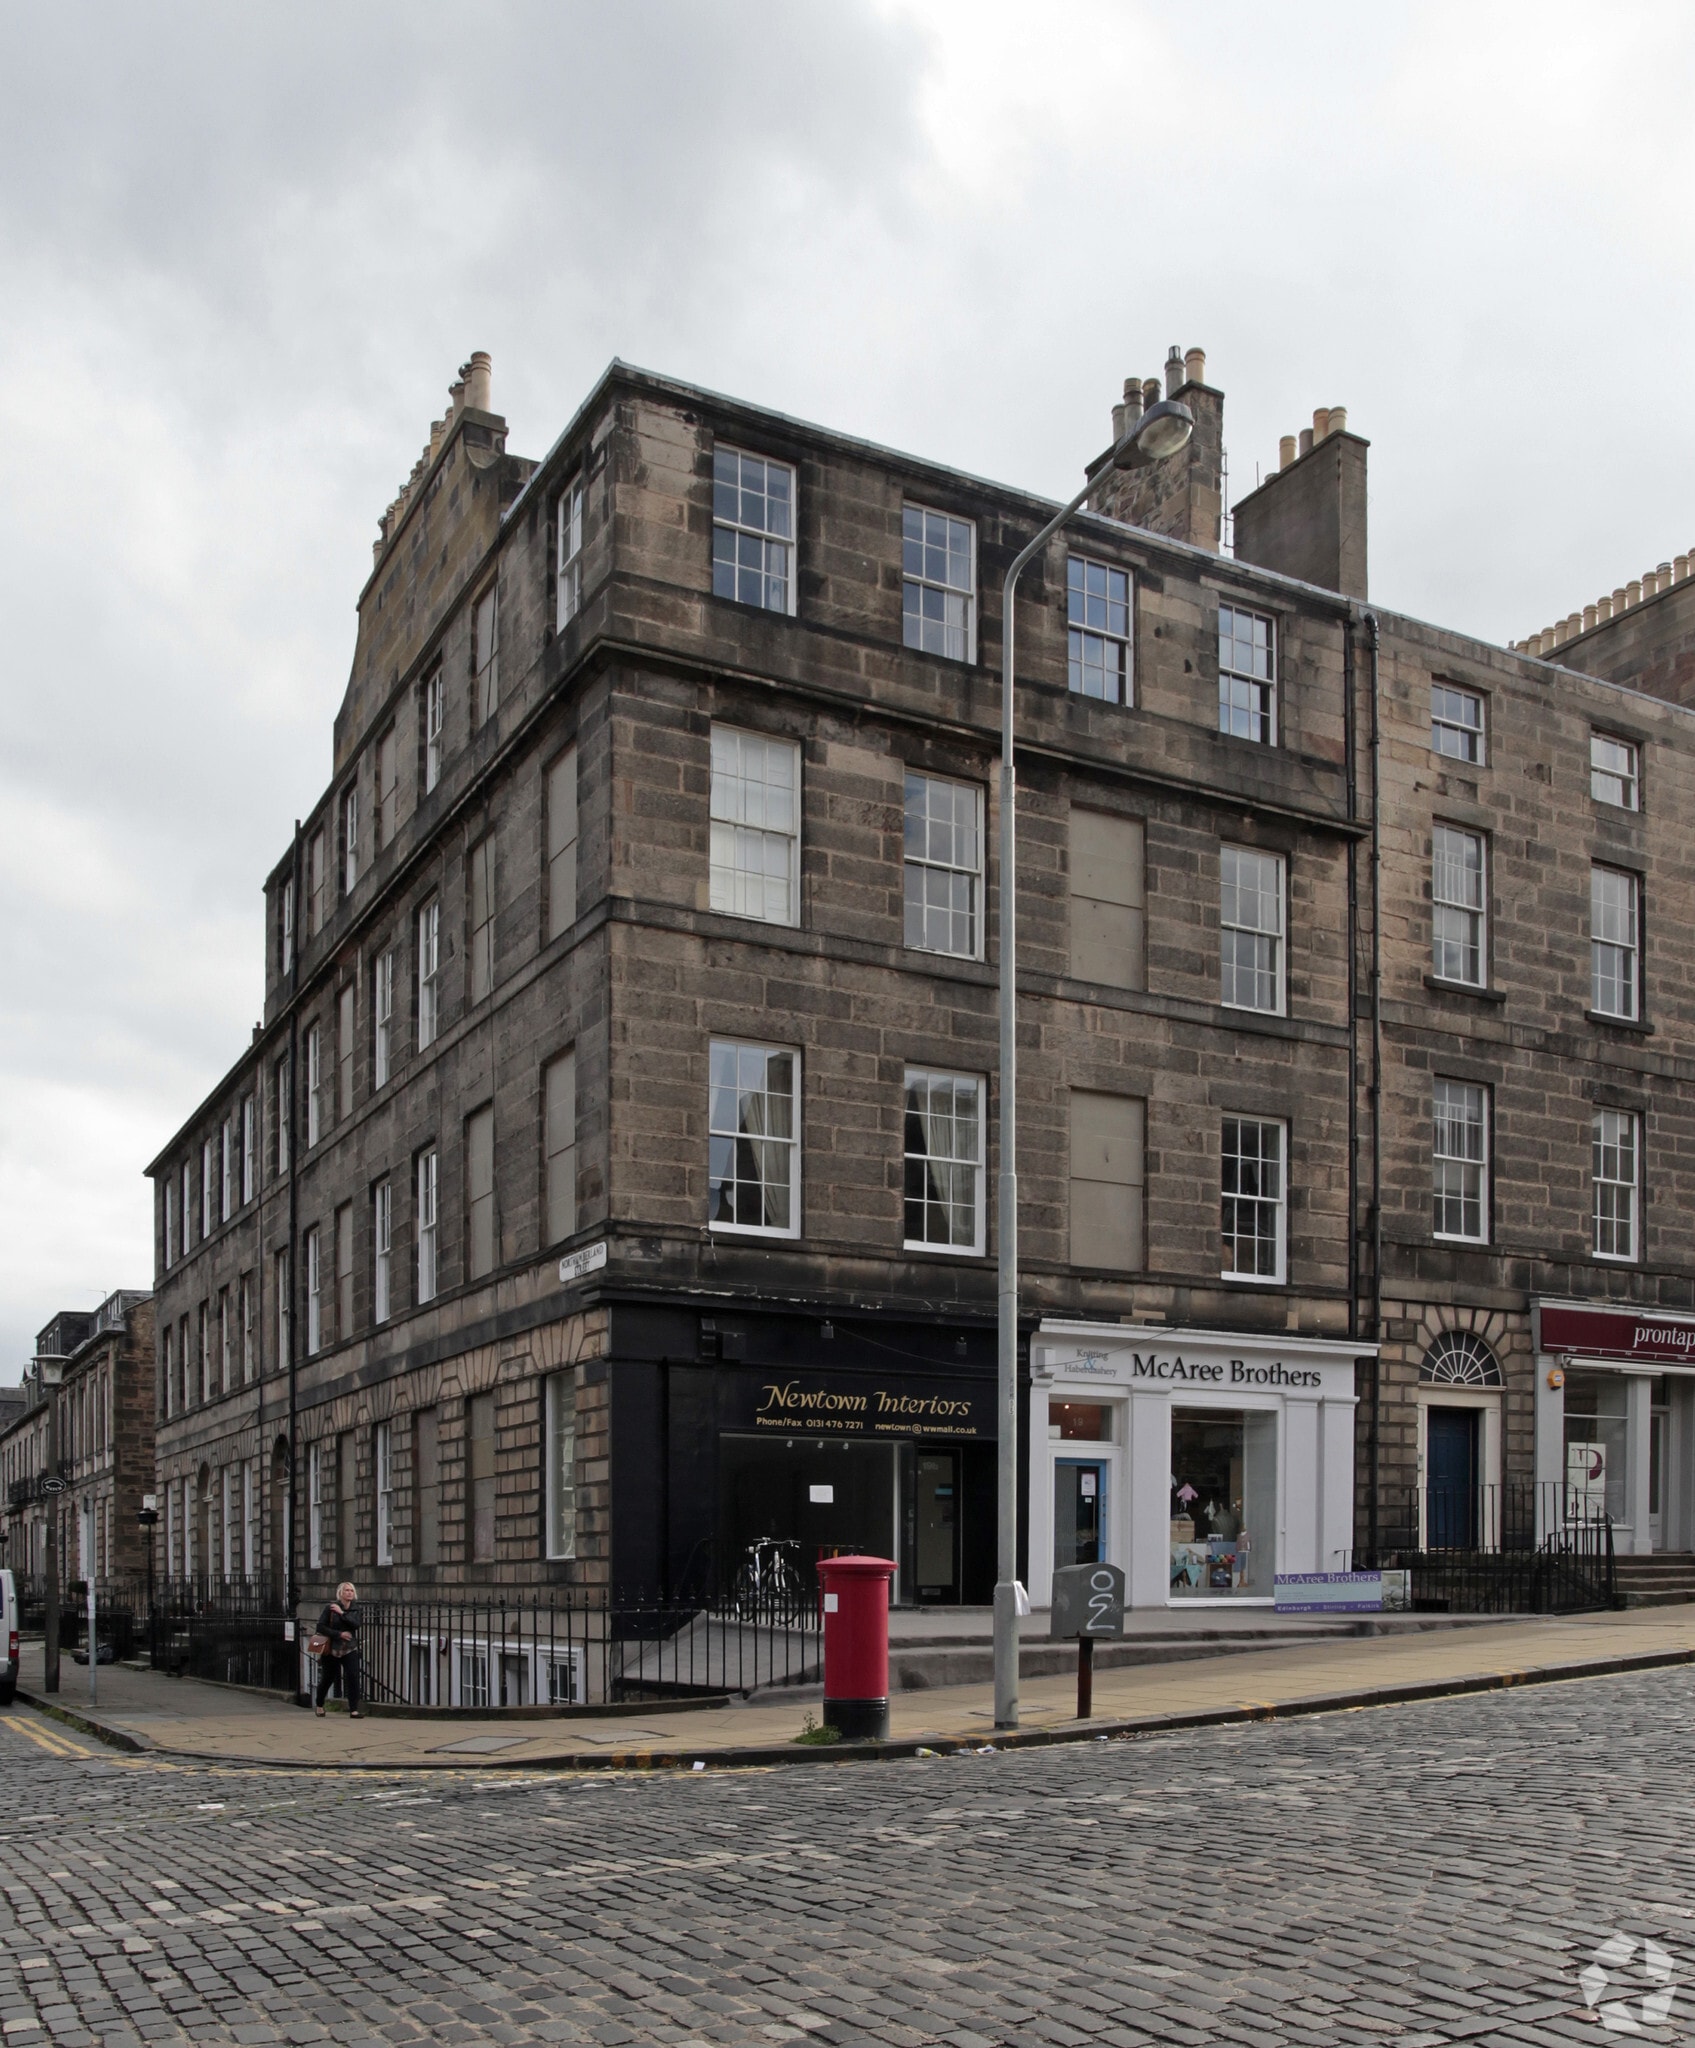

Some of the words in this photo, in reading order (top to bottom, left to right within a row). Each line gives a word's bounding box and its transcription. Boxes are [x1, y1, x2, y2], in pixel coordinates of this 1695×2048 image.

[561, 1244, 604, 1269] NORTHUMBERLAND
[574, 1261, 590, 1277] STREET
[1076, 1348, 1109, 1361] Knitting
[1064, 1364, 1117, 1378] Haberdashery
[1132, 1353, 1223, 1382] McAree
[1230, 1359, 1322, 1387] Brothers
[756, 1380, 868, 1412] Newtown
[872, 1391, 972, 1416] Interiors
[756, 1416, 802, 1428] Phone/Fax
[806, 1418, 824, 1428] 0131
[825, 1420, 843, 1429] 476
[845, 1420, 864, 1430] 7271
[1277, 1574, 1325, 1585] McAree
[1327, 1572, 1379, 1583] Brothers
